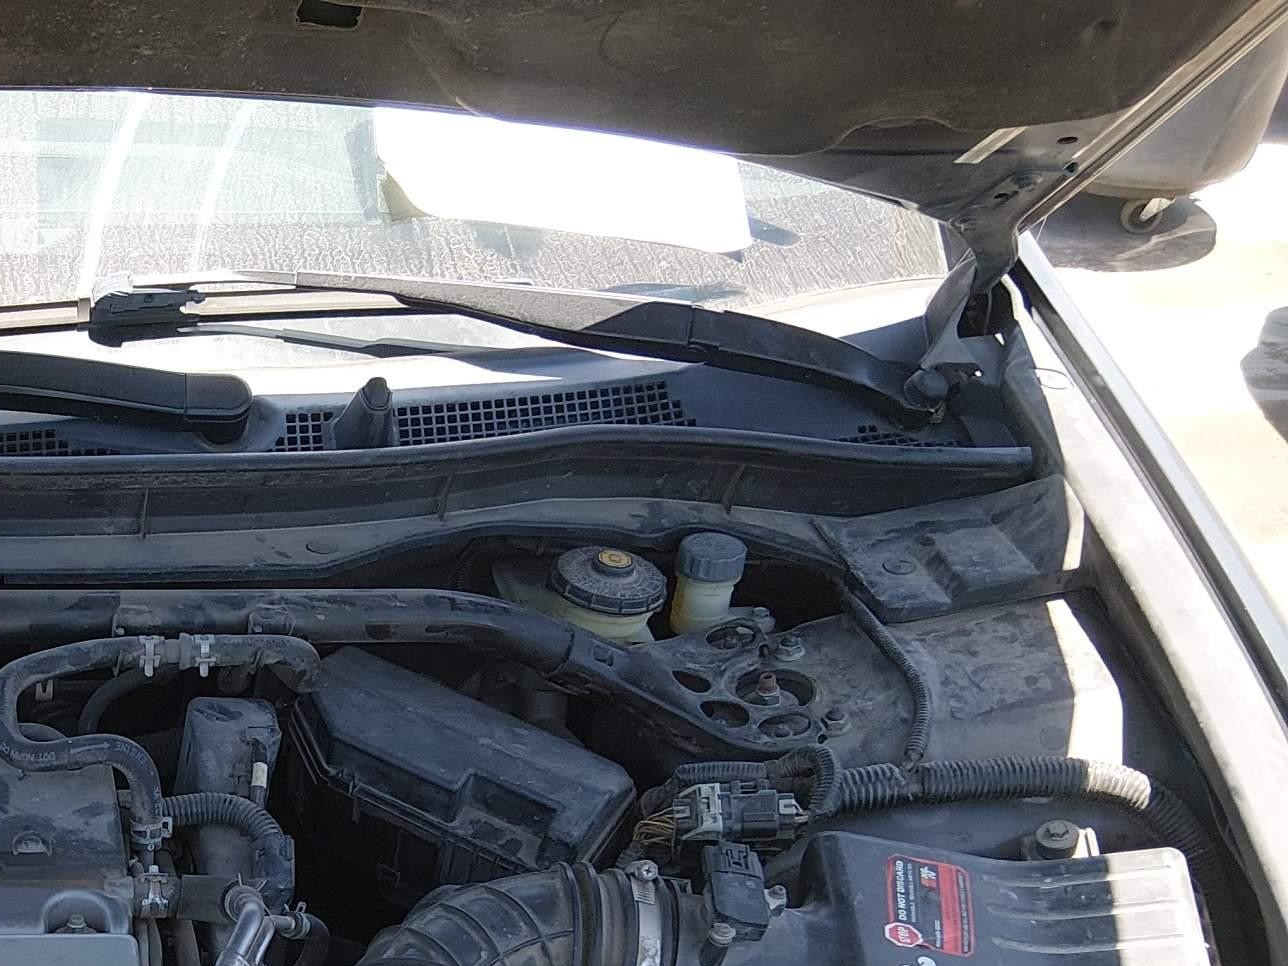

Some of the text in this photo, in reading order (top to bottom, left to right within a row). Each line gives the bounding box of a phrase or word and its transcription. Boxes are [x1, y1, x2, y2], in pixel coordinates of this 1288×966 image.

[895, 861, 907, 921] DO NOT DISCARD
[898, 926, 911, 944] STOP
